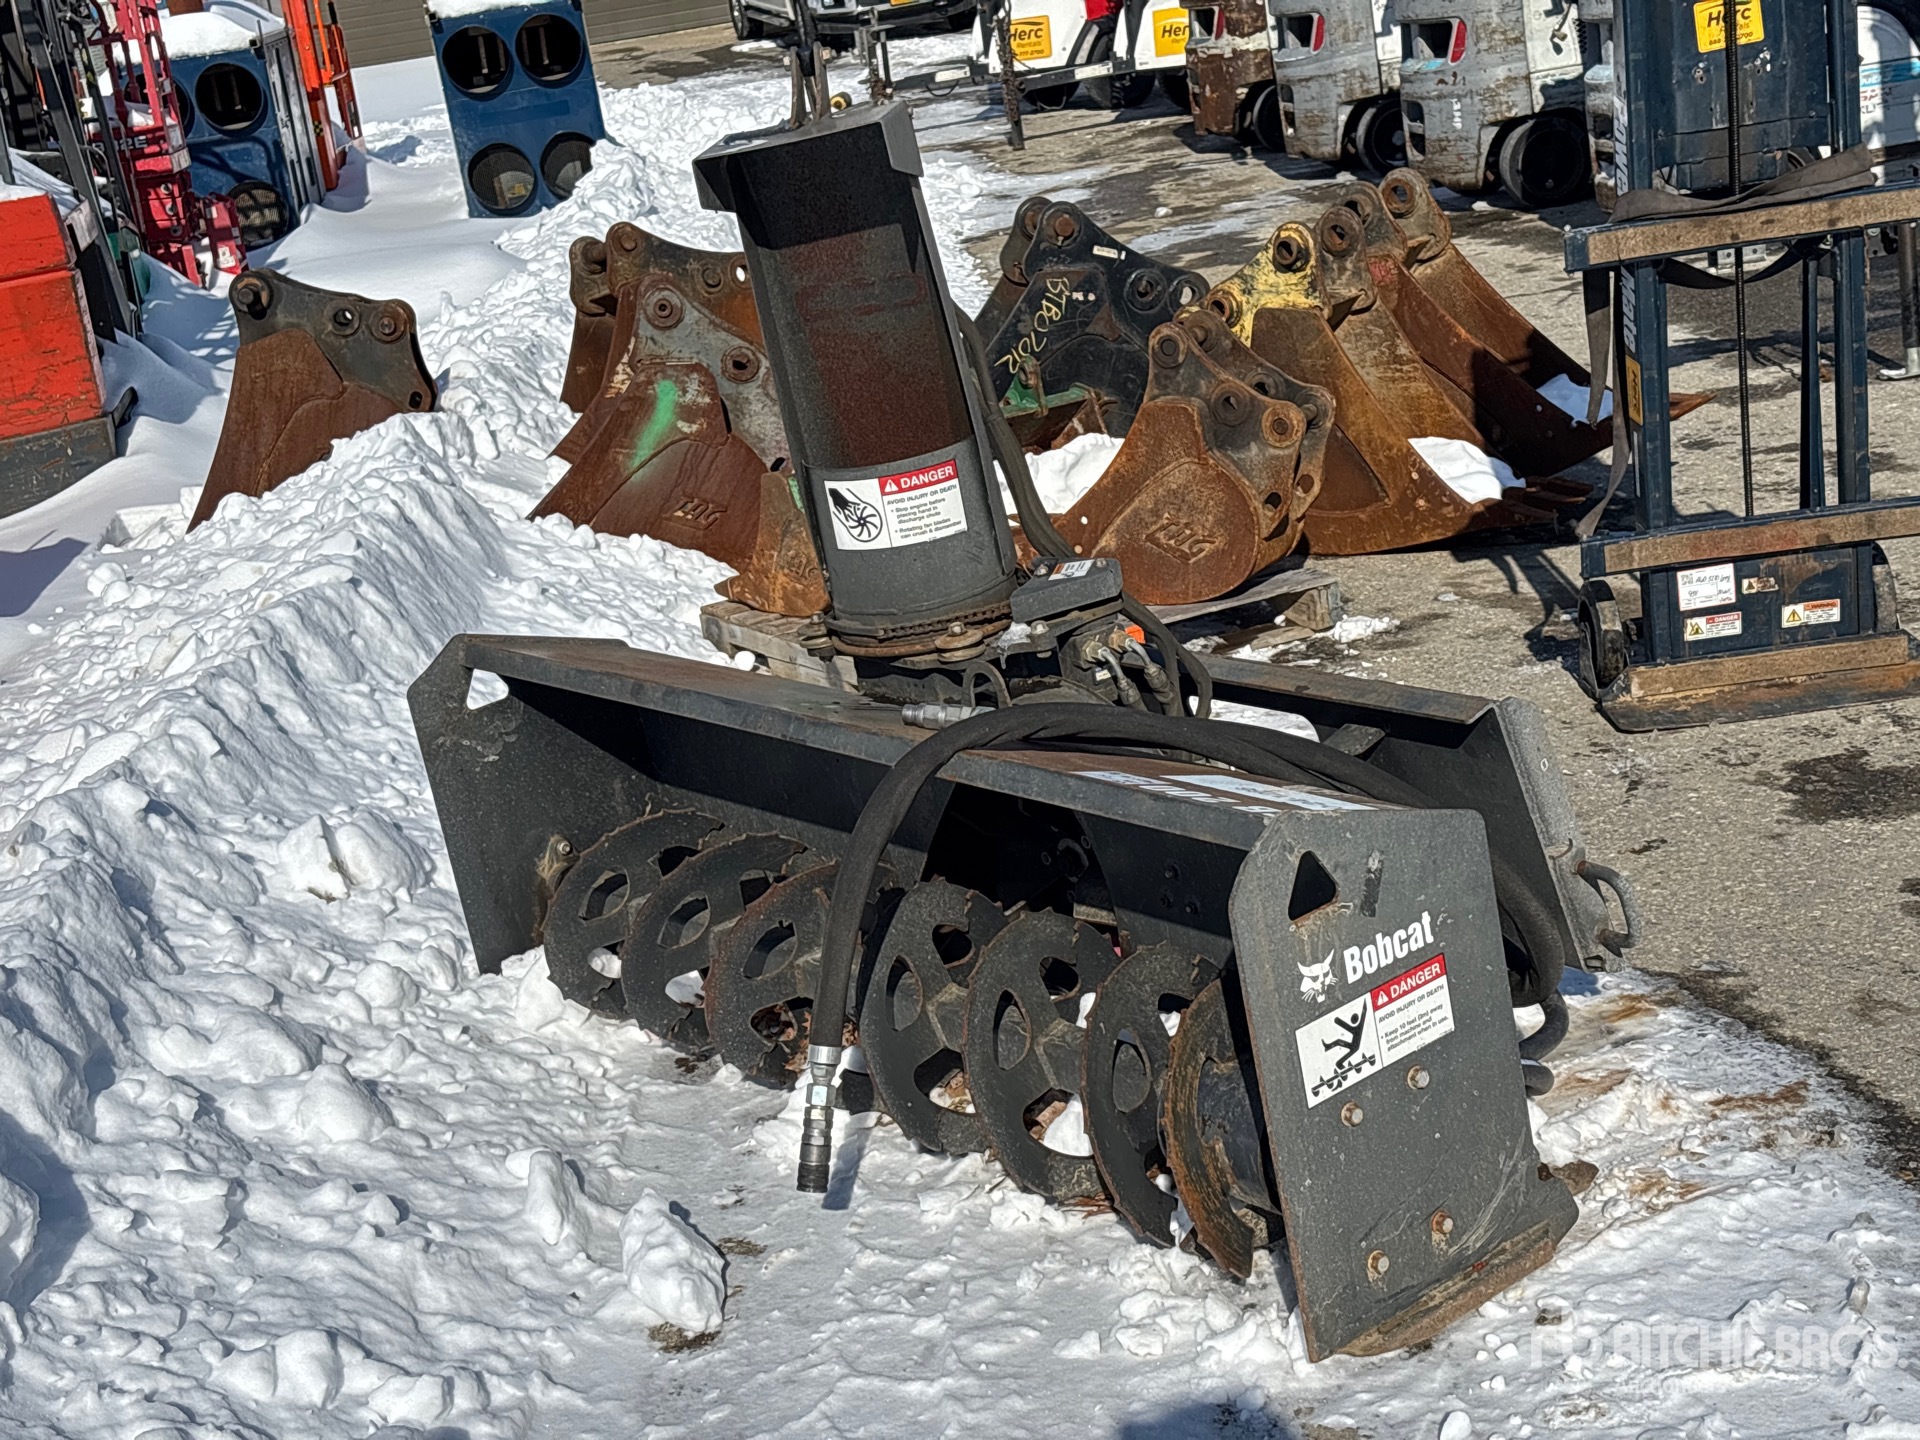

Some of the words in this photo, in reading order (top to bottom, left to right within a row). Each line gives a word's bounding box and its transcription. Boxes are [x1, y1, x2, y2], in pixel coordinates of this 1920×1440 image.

[1707, 8, 1752, 28] Hc
[1010, 27, 1044, 42] Herc
[1161, 24, 1190, 39] Her
[1613, 95, 1630, 197] Powe
[1620, 264, 1638, 353] Mate
[900, 465, 954, 489] DANGER
[886, 497, 906, 506] AVOID
[906, 491, 929, 502] INJURY
[939, 483, 958, 494] DEATH
[895, 505, 909, 513] Stop
[909, 502, 928, 511] engine
[928, 497, 946, 506] before
[896, 510, 917, 519] placing
[917, 506, 932, 514] hand
[897, 515, 925, 524] discharge
[925, 510, 941, 519] chute
[899, 525, 923, 533] Rotating
[933, 517, 951, 526] blades
[912, 529, 928, 537] crush
[1714, 613, 1739, 623] DANGER
[1343, 910, 1435, 985] Bobcat
[1390, 962, 1441, 999] DANGER
[1378, 1010, 1396, 1024] AVOID
[1396, 999, 1416, 1014] INJURY
[1416, 993, 1426, 1003] OR
[1426, 983, 1445, 998] DEATH
[1384, 1027, 1399, 1039] Keep
[1399, 1022, 1406, 1030] 10
[1406, 1016, 1417, 1026] feet
[1429, 1003, 1444, 1015] away
[1385, 1034, 1399, 1045] from
[1399, 1022, 1422, 1037] machine
[1422, 1016, 1433, 1026] and
[1387, 1033, 1417, 1052] attachment
[1417, 1024, 1432, 1035] when
